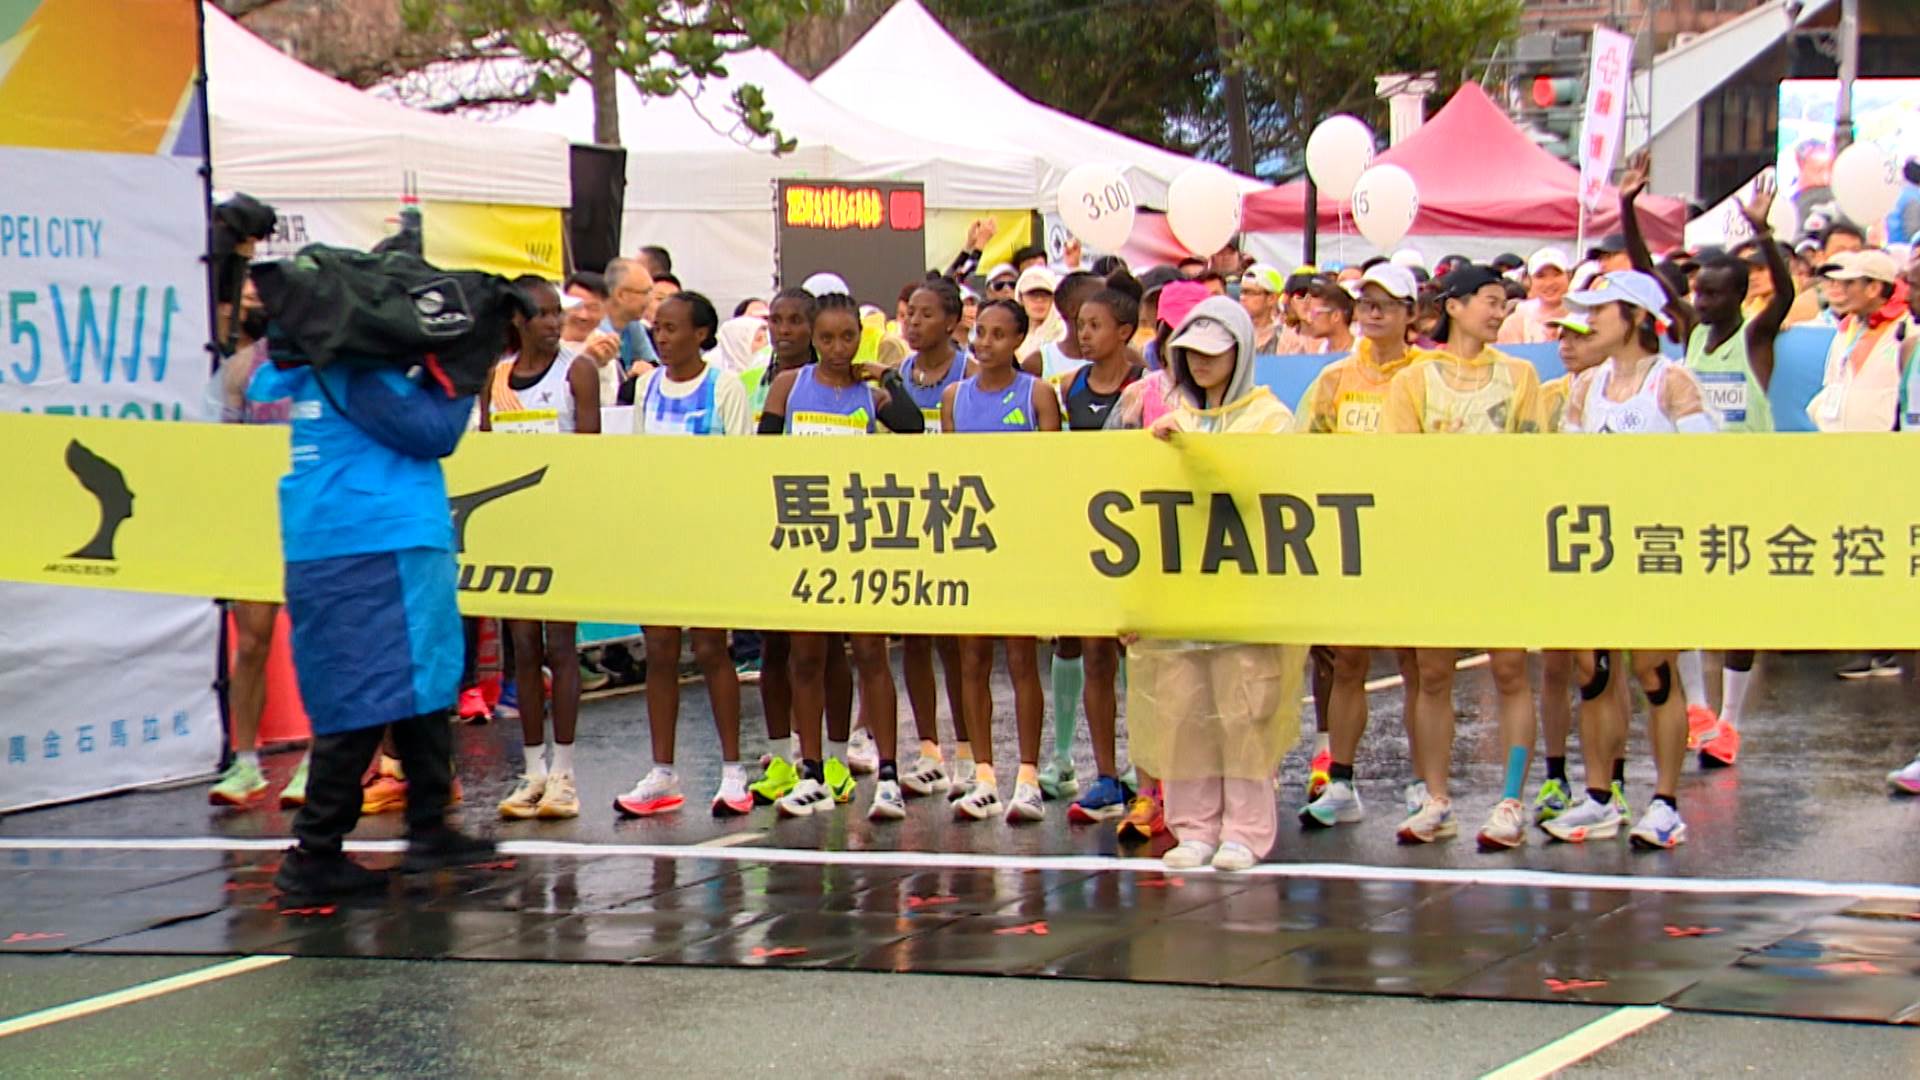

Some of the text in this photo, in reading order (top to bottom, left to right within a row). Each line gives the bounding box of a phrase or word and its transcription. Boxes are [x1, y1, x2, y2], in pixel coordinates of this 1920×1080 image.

[1082, 180, 1130, 220] 3:00
[47, 216, 104, 258] CITY
[769, 471, 998, 554] 馬拉松
[1087, 489, 1376, 578] START
[1633, 522, 1887, 577] 富邦金控
[457, 564, 554, 596] UNO
[790, 568, 971, 608] 42.195km
